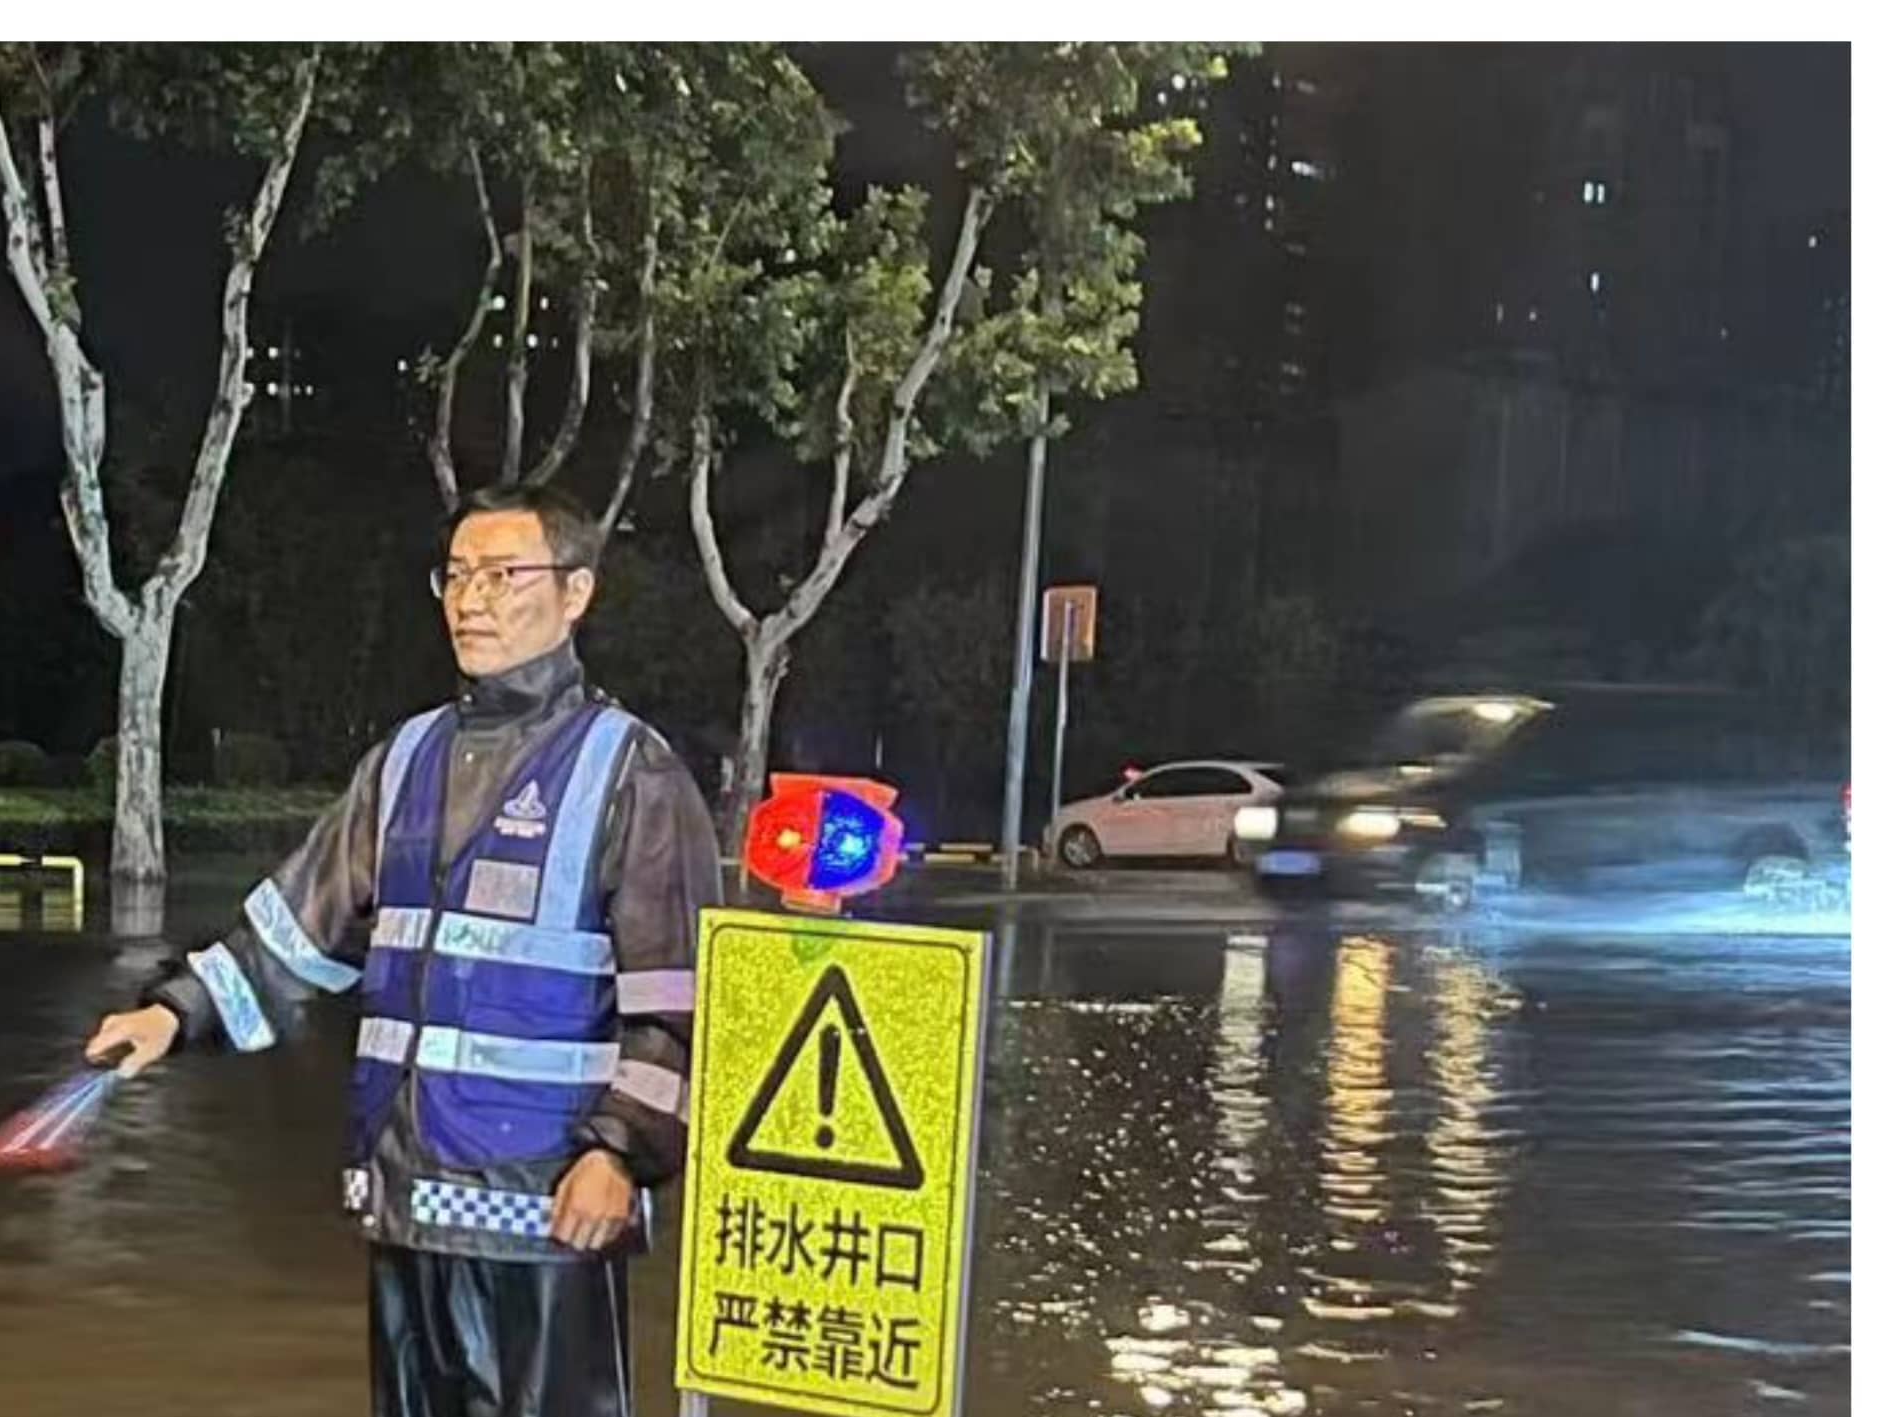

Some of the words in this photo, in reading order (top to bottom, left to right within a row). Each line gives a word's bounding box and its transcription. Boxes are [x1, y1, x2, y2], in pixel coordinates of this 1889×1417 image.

[714, 1193, 923, 1293] 排水井口
[708, 1290, 921, 1391] 严禁靠近
